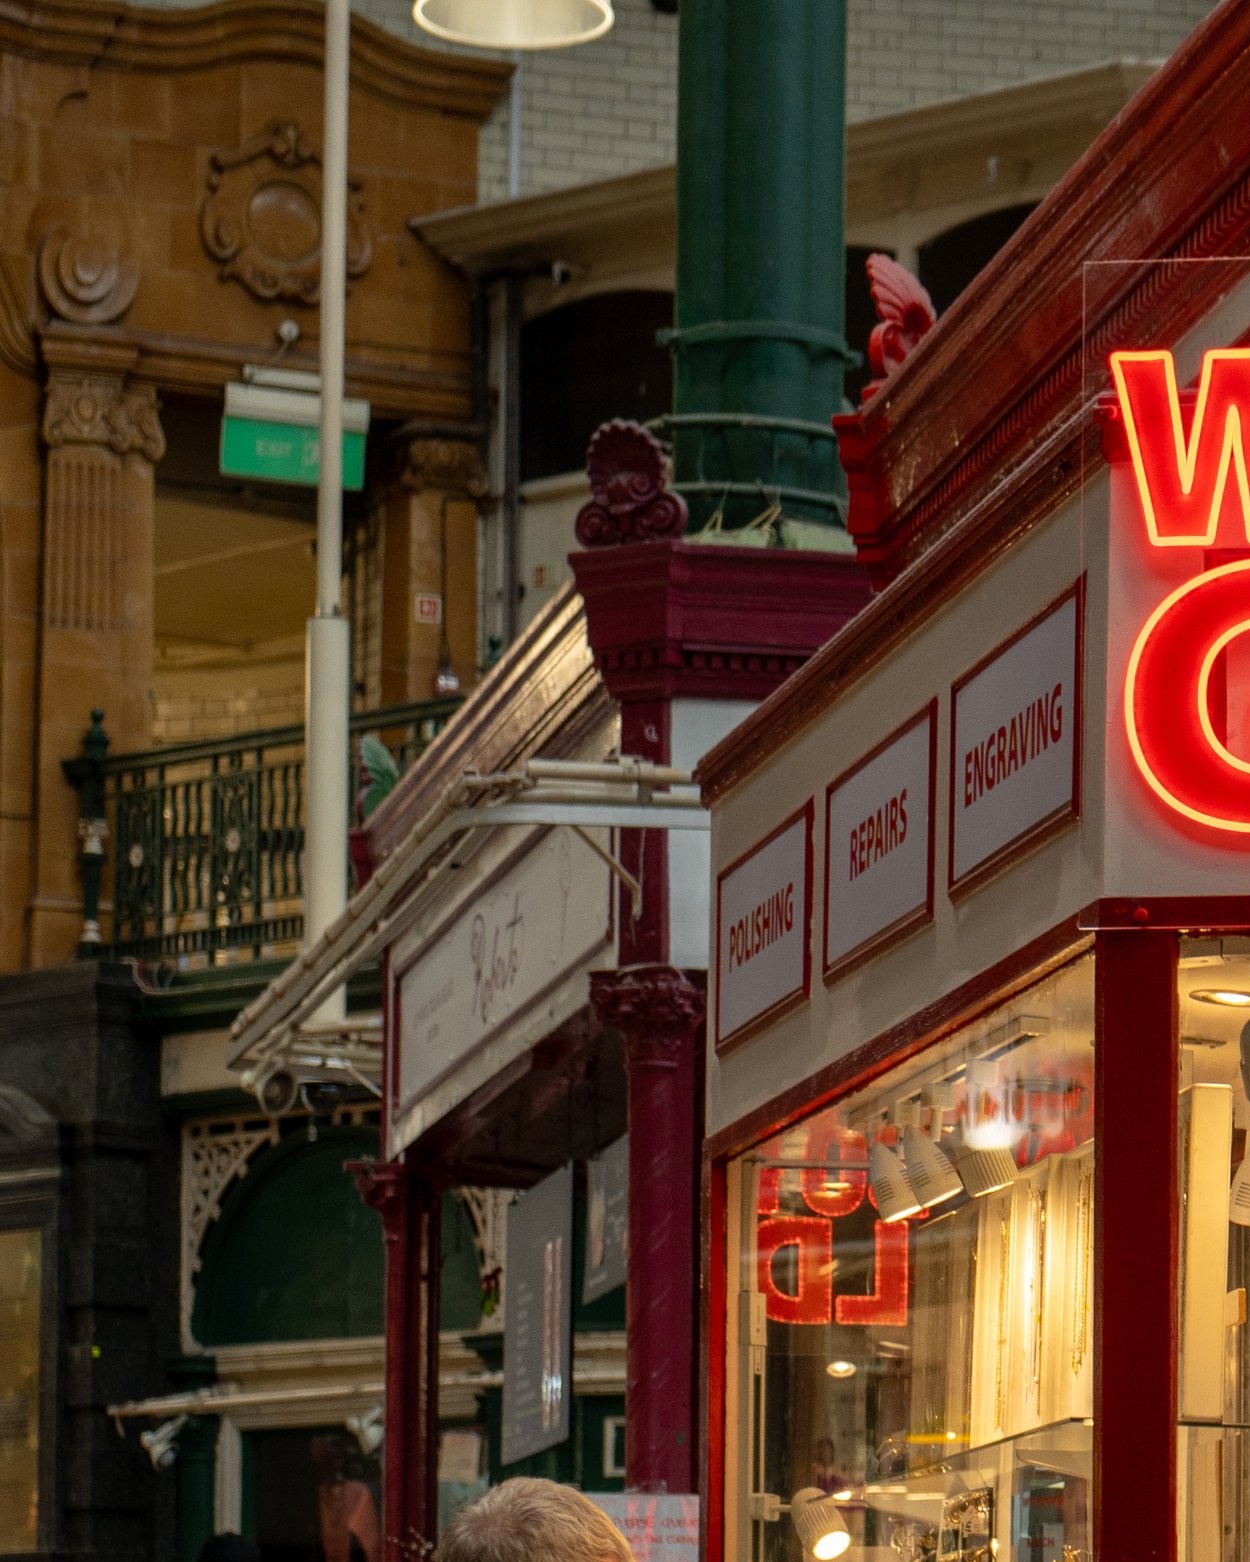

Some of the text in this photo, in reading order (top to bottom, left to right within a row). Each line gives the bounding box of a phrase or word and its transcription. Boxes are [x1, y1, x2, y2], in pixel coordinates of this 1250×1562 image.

[964, 682, 1063, 809] ENGRAVING
[850, 788, 908, 882] REPAIRS
[728, 881, 794, 973] POLISHING
